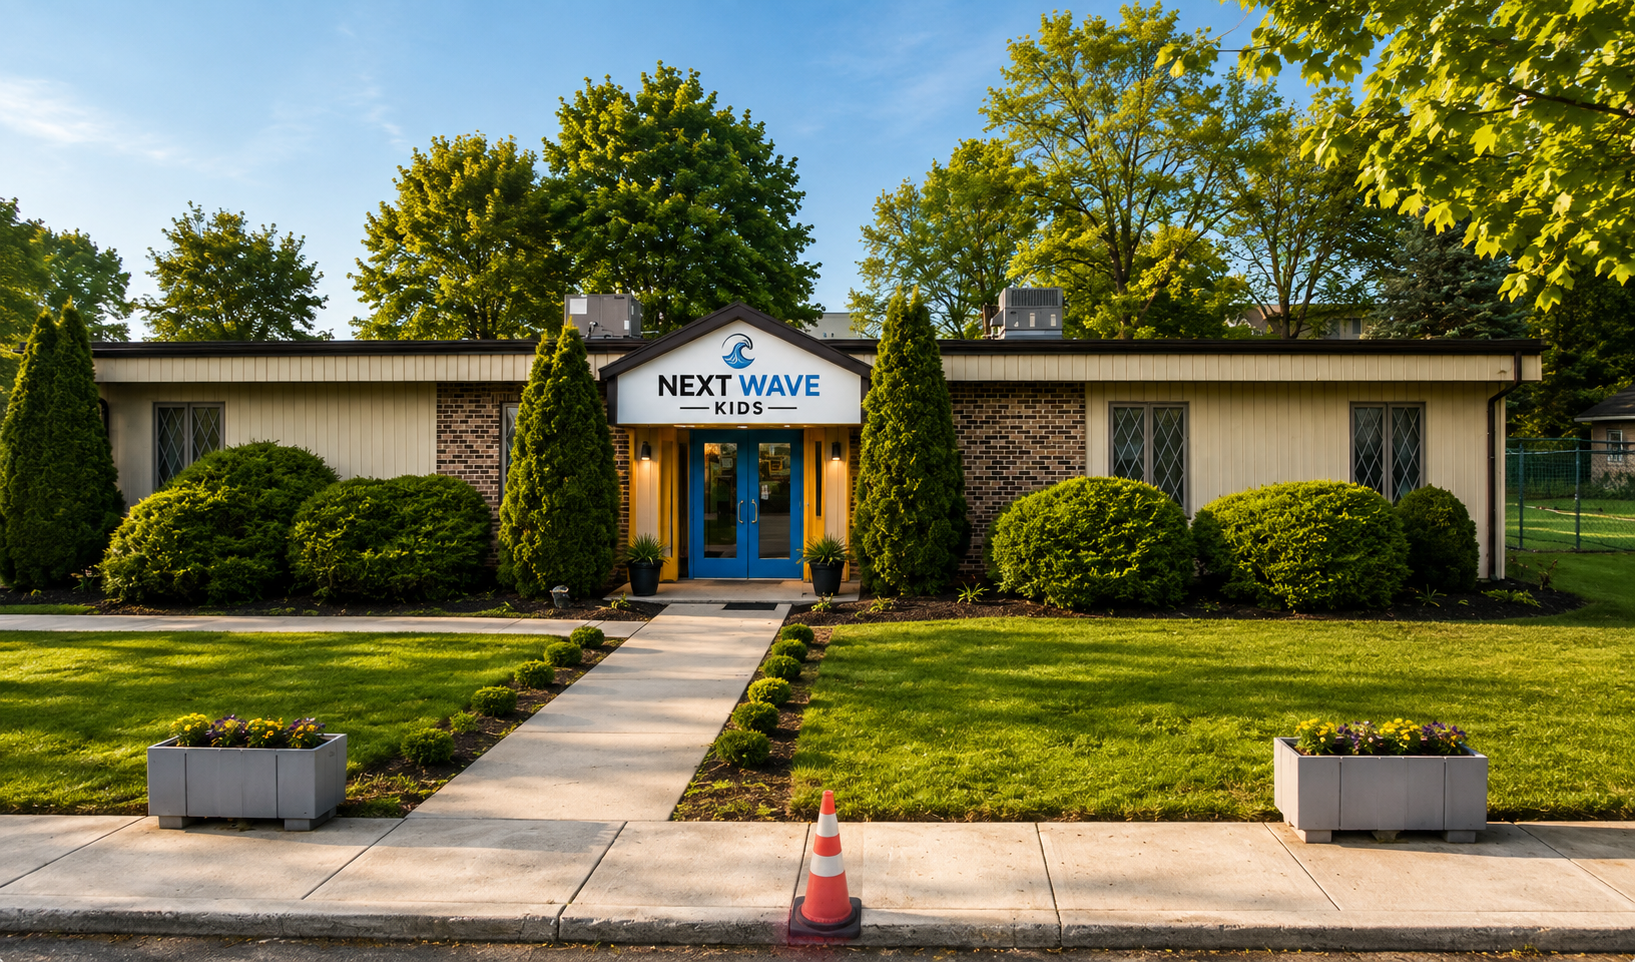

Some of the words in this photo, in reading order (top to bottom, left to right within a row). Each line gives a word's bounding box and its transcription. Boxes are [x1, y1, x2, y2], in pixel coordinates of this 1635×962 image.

[658, 375, 732, 396] NEXT
[739, 375, 820, 396] WAVE
[715, 401, 763, 415] KIDS
